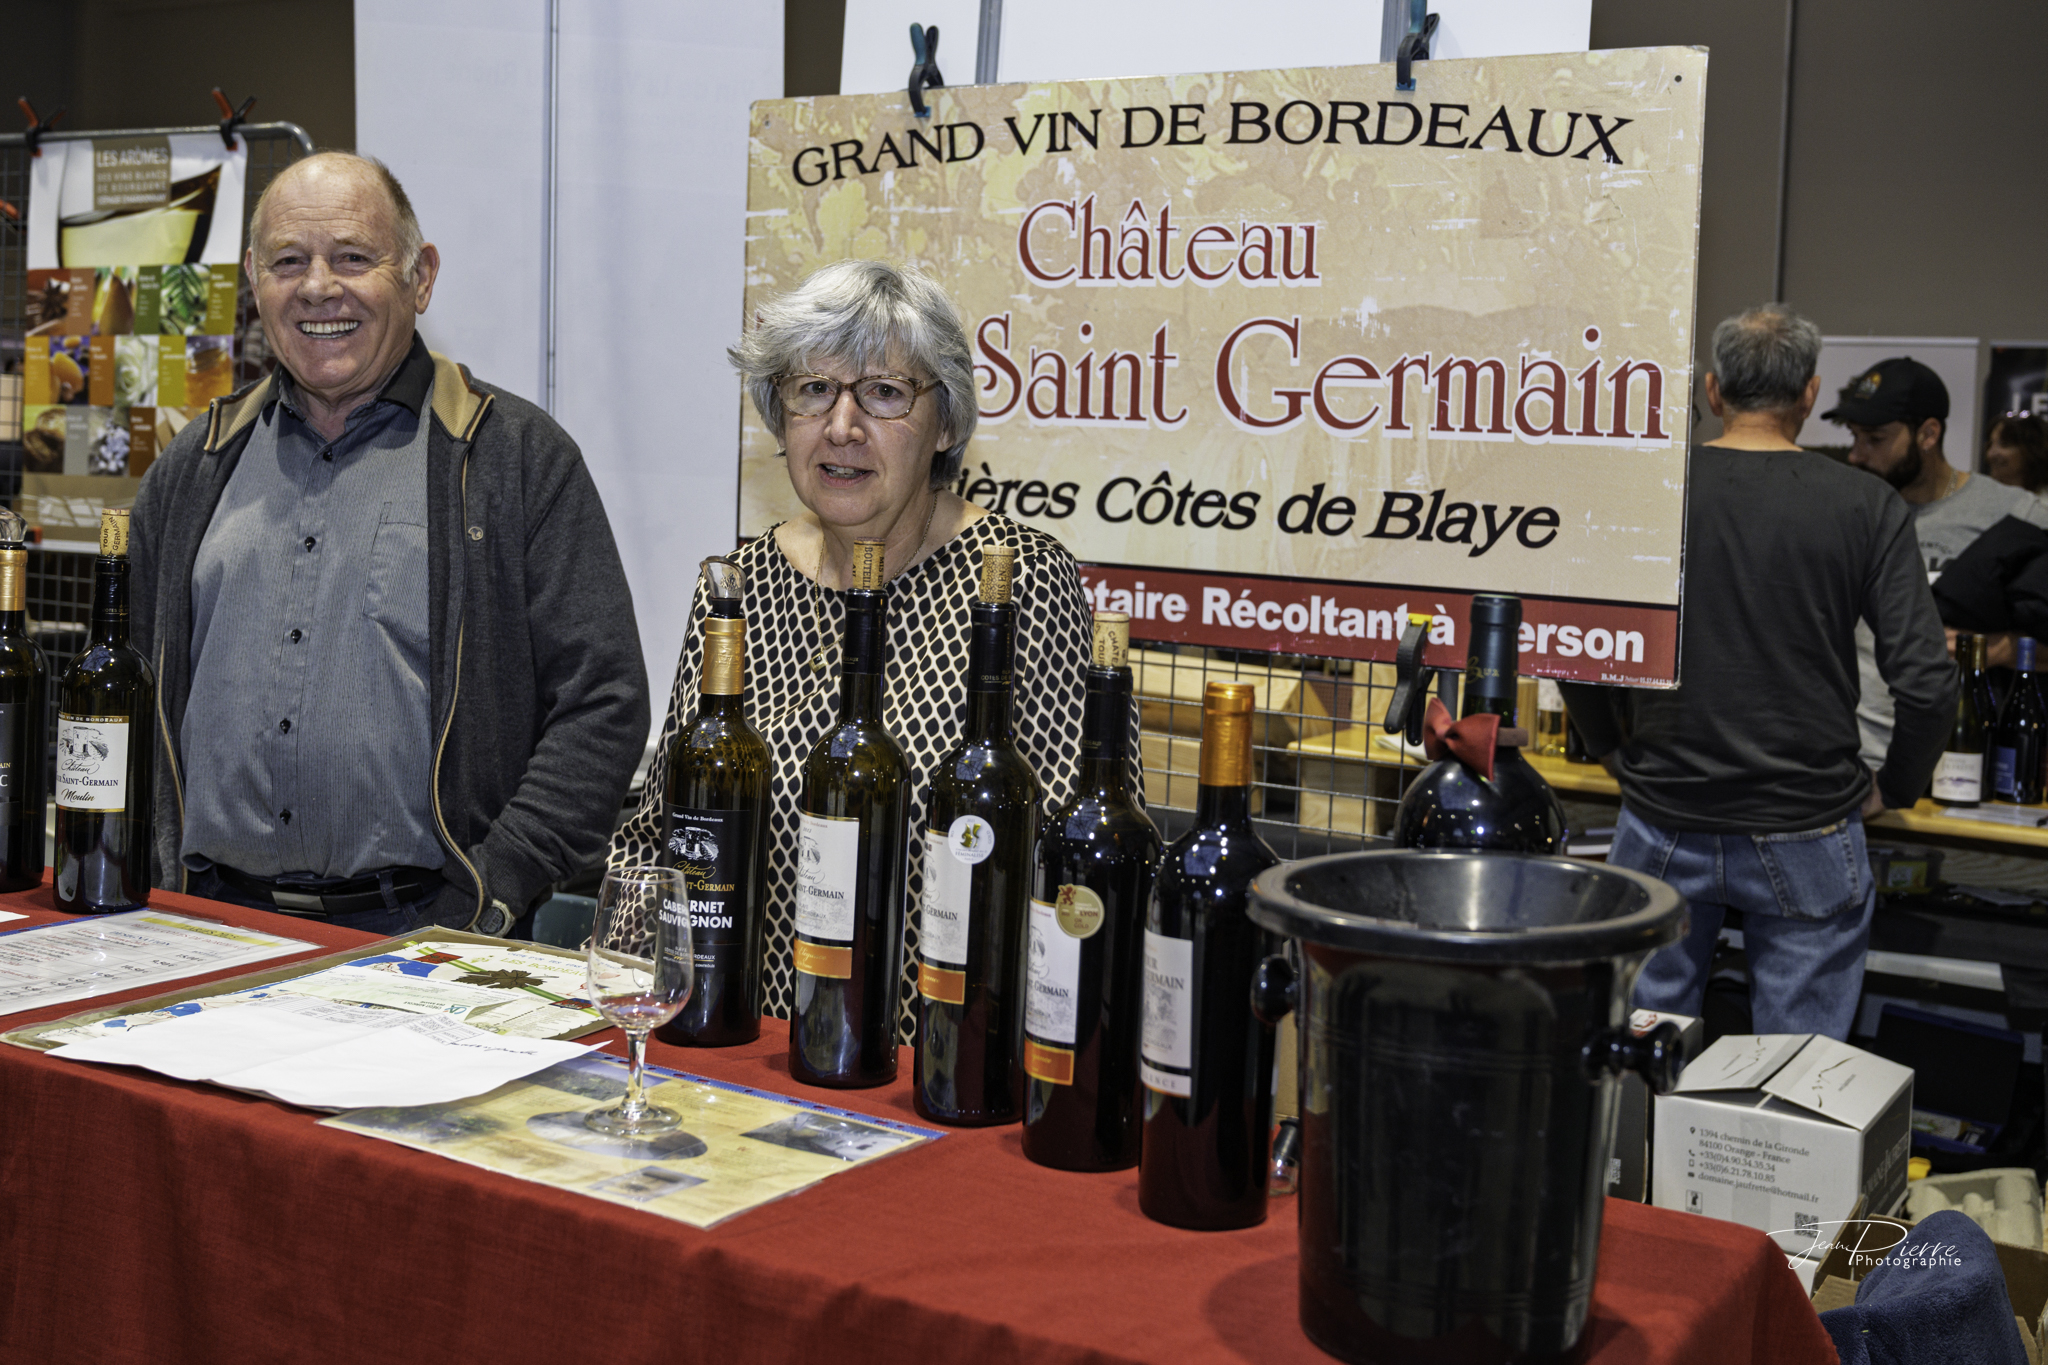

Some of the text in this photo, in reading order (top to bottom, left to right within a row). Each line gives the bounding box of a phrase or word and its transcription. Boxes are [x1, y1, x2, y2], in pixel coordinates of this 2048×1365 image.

[96, 149, 119, 168] LES
[792, 100, 1634, 187] GRAND VIN DE BORDEAUX
[1017, 191, 1321, 287] Château
[973, 310, 1672, 448] Saint Germain
[957, 461, 1561, 558] ières Côtes de Blaye
[110, 516, 122, 551] GERMAIN
[863, 546, 873, 591] BOUTEILL
[877, 575, 884, 587] EN
[996, 570, 1006, 601] MIS EN
[1202, 586, 1409, 642] Récoltant
[1429, 604, 1455, 646] à
[1516, 620, 1645, 663] erson
[1108, 630, 1120, 667] CHATE
[61, 758, 100, 775] Château
[61, 788, 95, 803] Moulin
[659, 909, 733, 929] SAUVIGNON
[528, 962, 588, 977] BORDEAU
[1698, 1139, 1723, 1151] 84100
[1724, 1143, 1755, 1158] Orange
[1762, 1151, 1791, 1164] France
[1699, 1128, 1810, 1156] 1394 chemin de la Gironde
[1698, 1172, 1820, 1204] domaine.jaufrette@hotmail.fr
